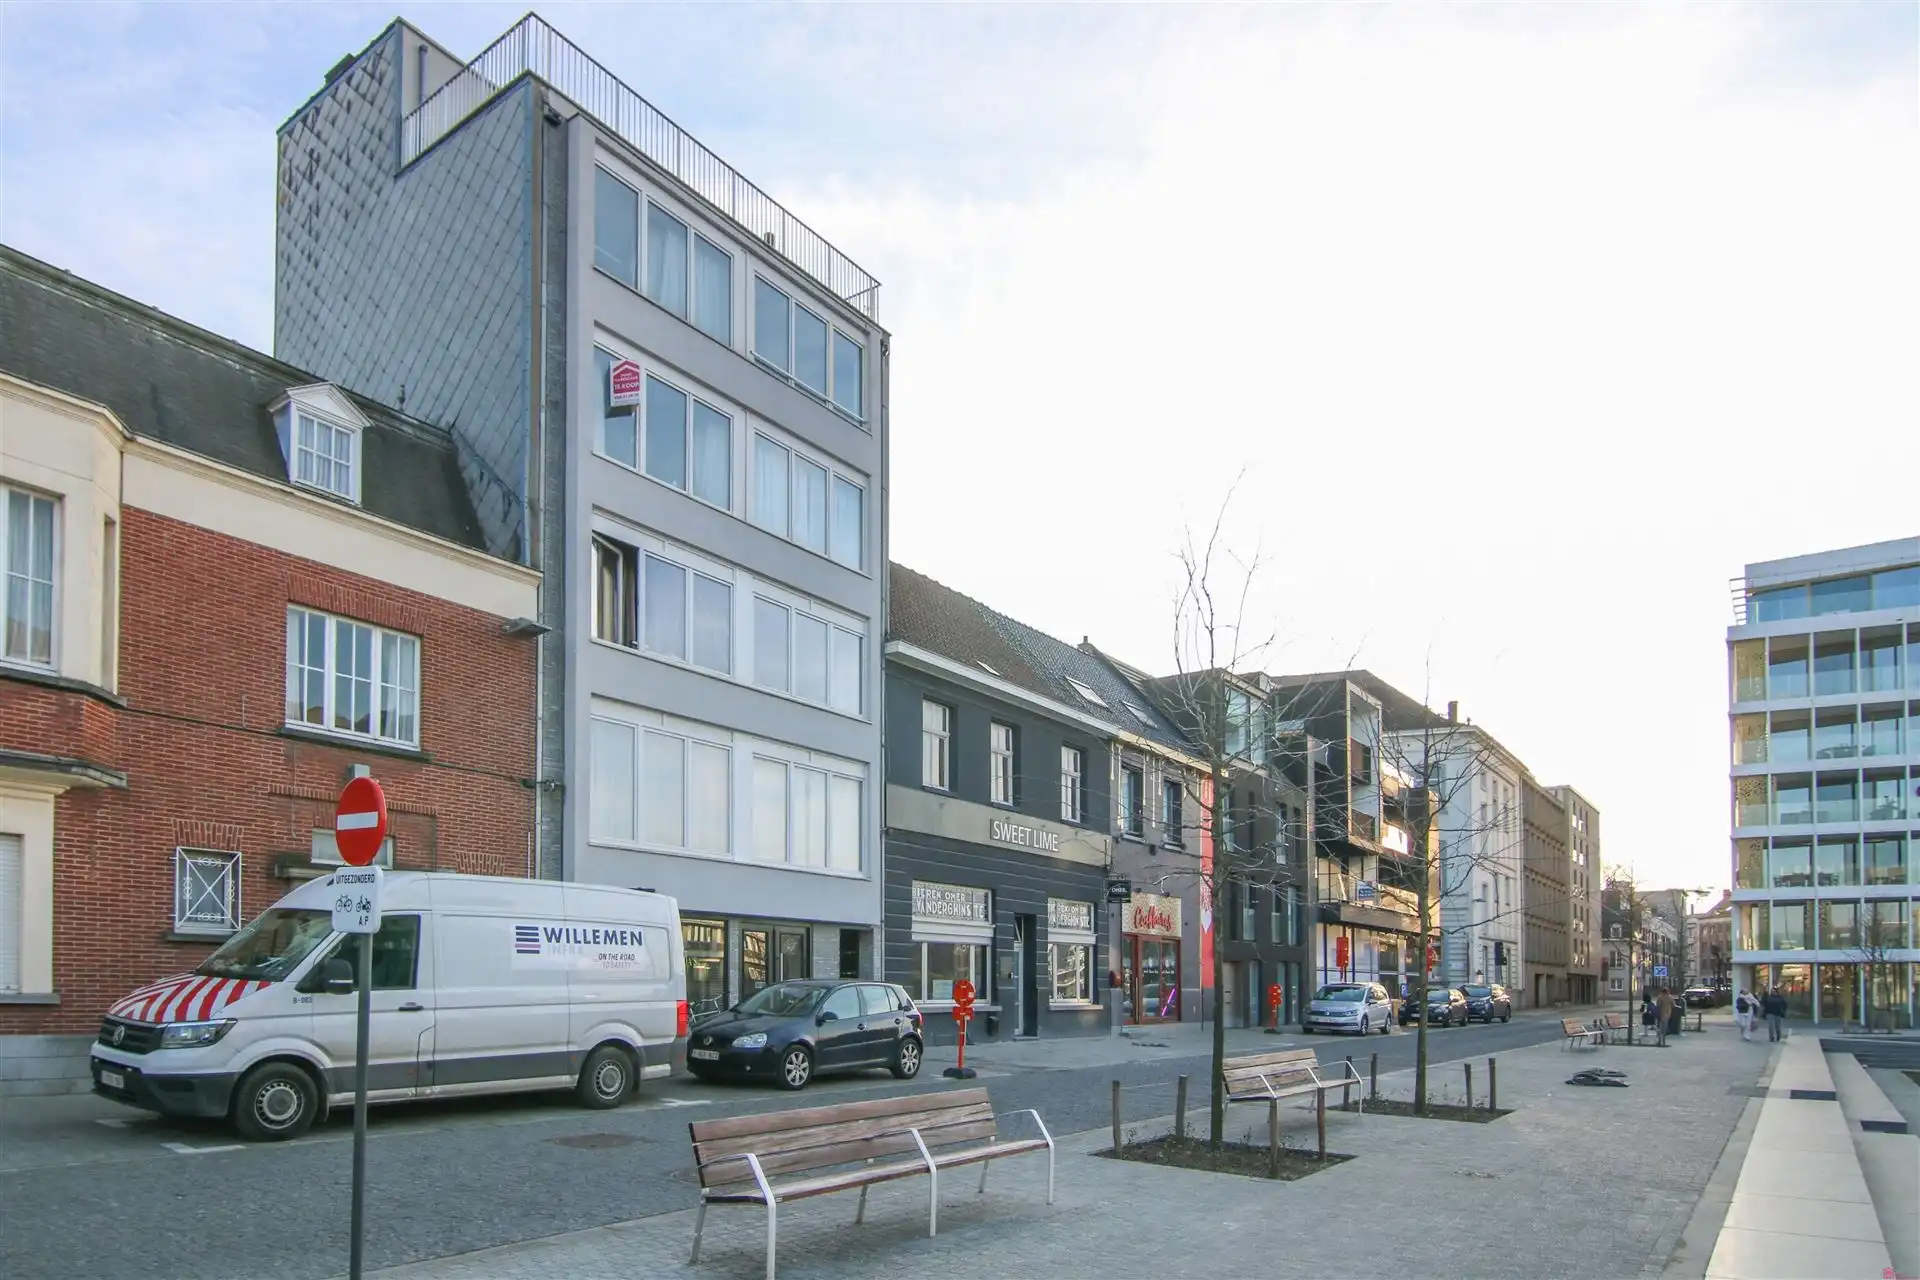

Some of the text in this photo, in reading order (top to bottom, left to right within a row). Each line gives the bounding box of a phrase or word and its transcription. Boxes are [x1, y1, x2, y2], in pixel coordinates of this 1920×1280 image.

[993, 820, 1059, 852] SWEET LIME
[335, 873, 376, 885] UITGEZONDERD
[944, 891, 966, 903] OMER
[543, 926, 643, 946] WILLEMEN
[598, 953, 636, 961] ON THE ROAD
